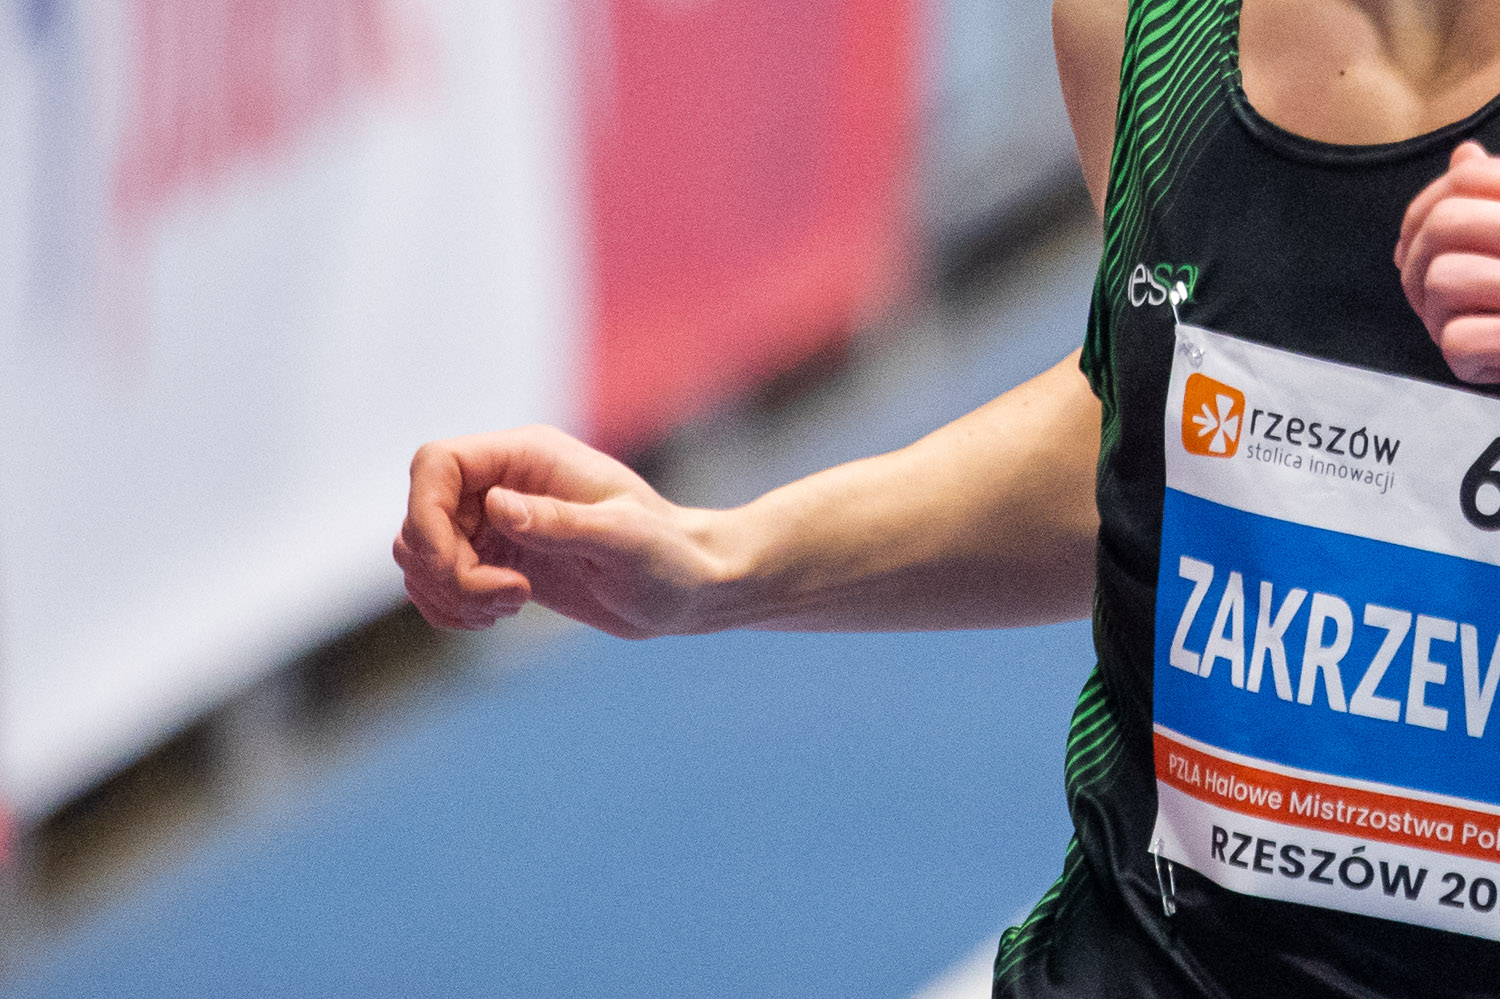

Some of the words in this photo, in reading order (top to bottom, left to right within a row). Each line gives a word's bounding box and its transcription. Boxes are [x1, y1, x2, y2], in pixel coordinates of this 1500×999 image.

[1247, 442, 1303, 469] stolica
[1309, 455, 1395, 494] innowacji
[1250, 408, 1400, 465] rzeszów
[1168, 753, 1201, 789] PZLA
[1204, 768, 1283, 811] Halowe
[1289, 791, 1454, 842] Mistrzostwa
[1210, 824, 1430, 901] RZESZÓW
